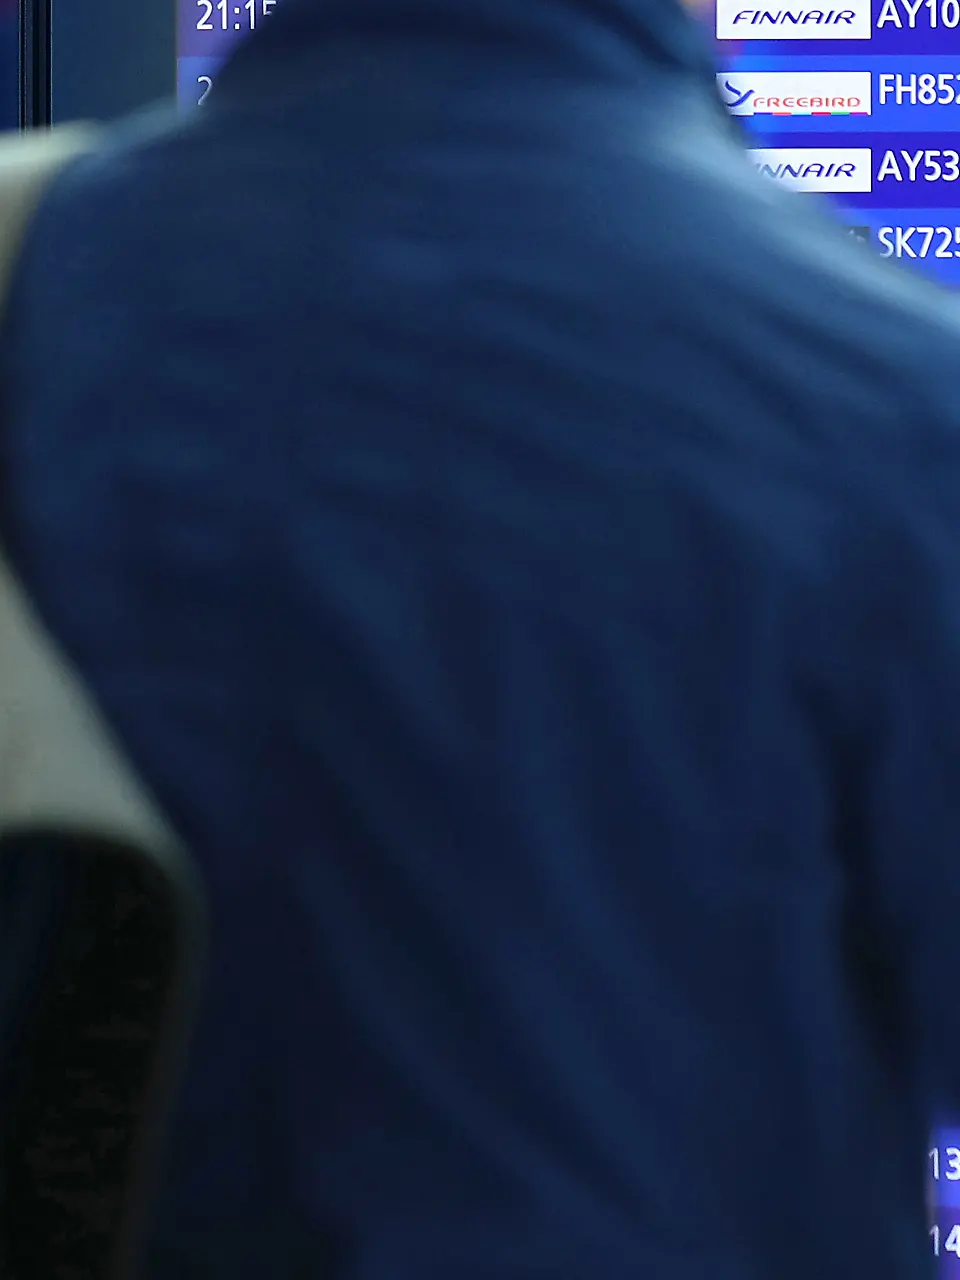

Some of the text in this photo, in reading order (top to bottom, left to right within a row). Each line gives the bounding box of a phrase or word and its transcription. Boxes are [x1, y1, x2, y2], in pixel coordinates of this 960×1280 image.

[732, 10, 856, 25] FINNAIR
[879, 73, 960, 105] FH85
[753, 96, 861, 108] FREEBIRD
[877, 150, 960, 182] AY53
